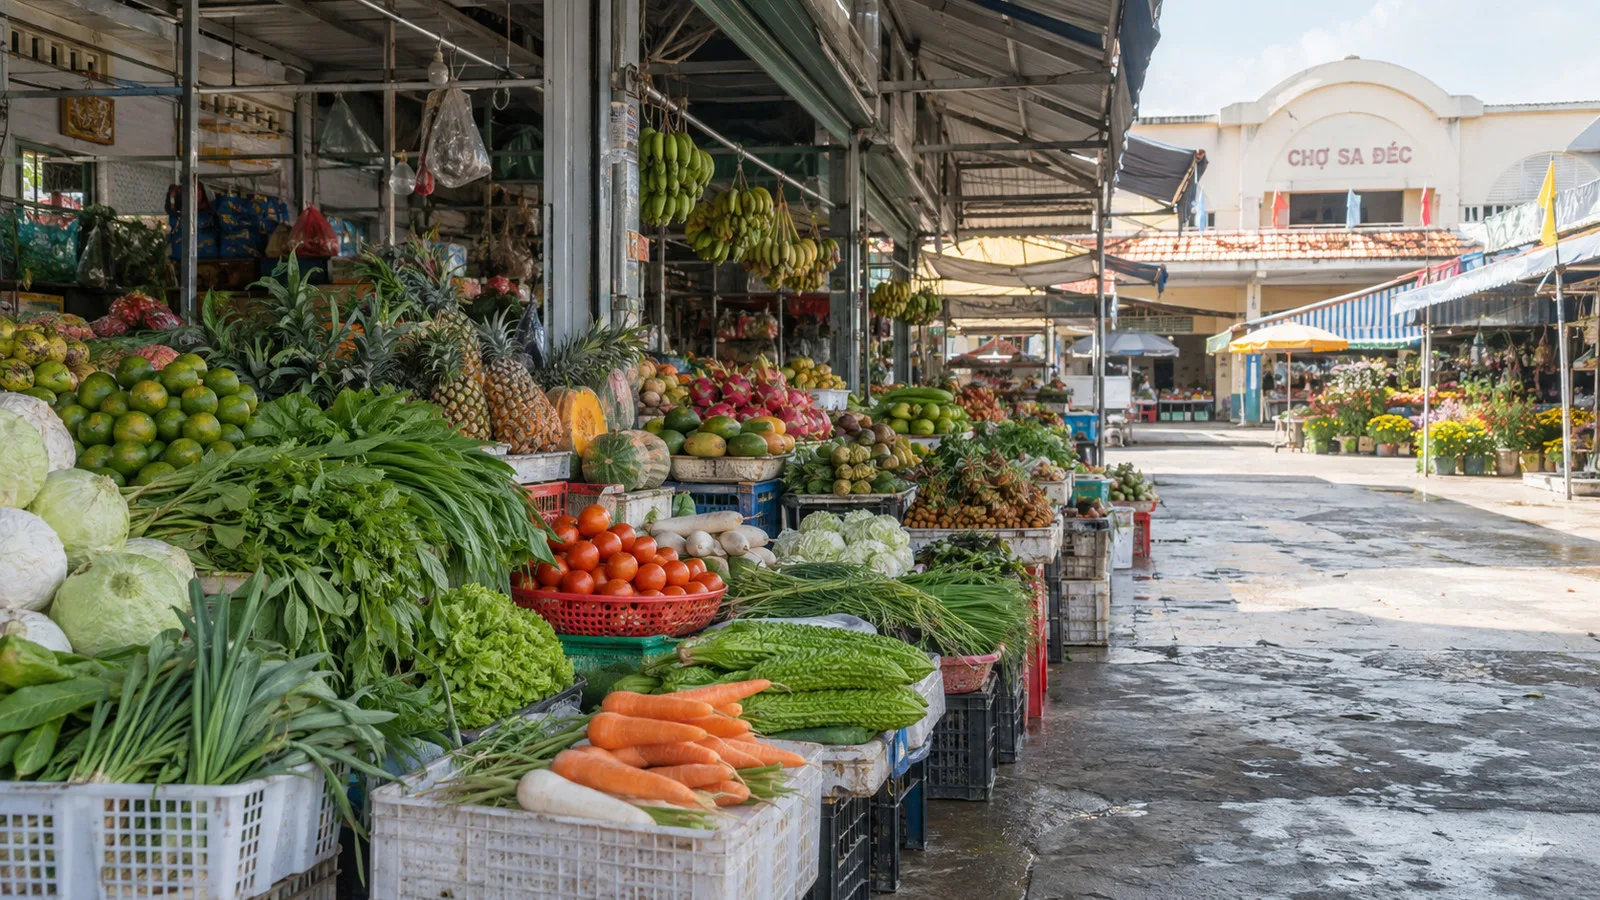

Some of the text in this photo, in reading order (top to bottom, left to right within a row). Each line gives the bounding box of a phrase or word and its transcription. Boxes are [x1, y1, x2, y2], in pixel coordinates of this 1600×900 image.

[1288, 141, 1412, 170] CHỢ SA ĐÉC
